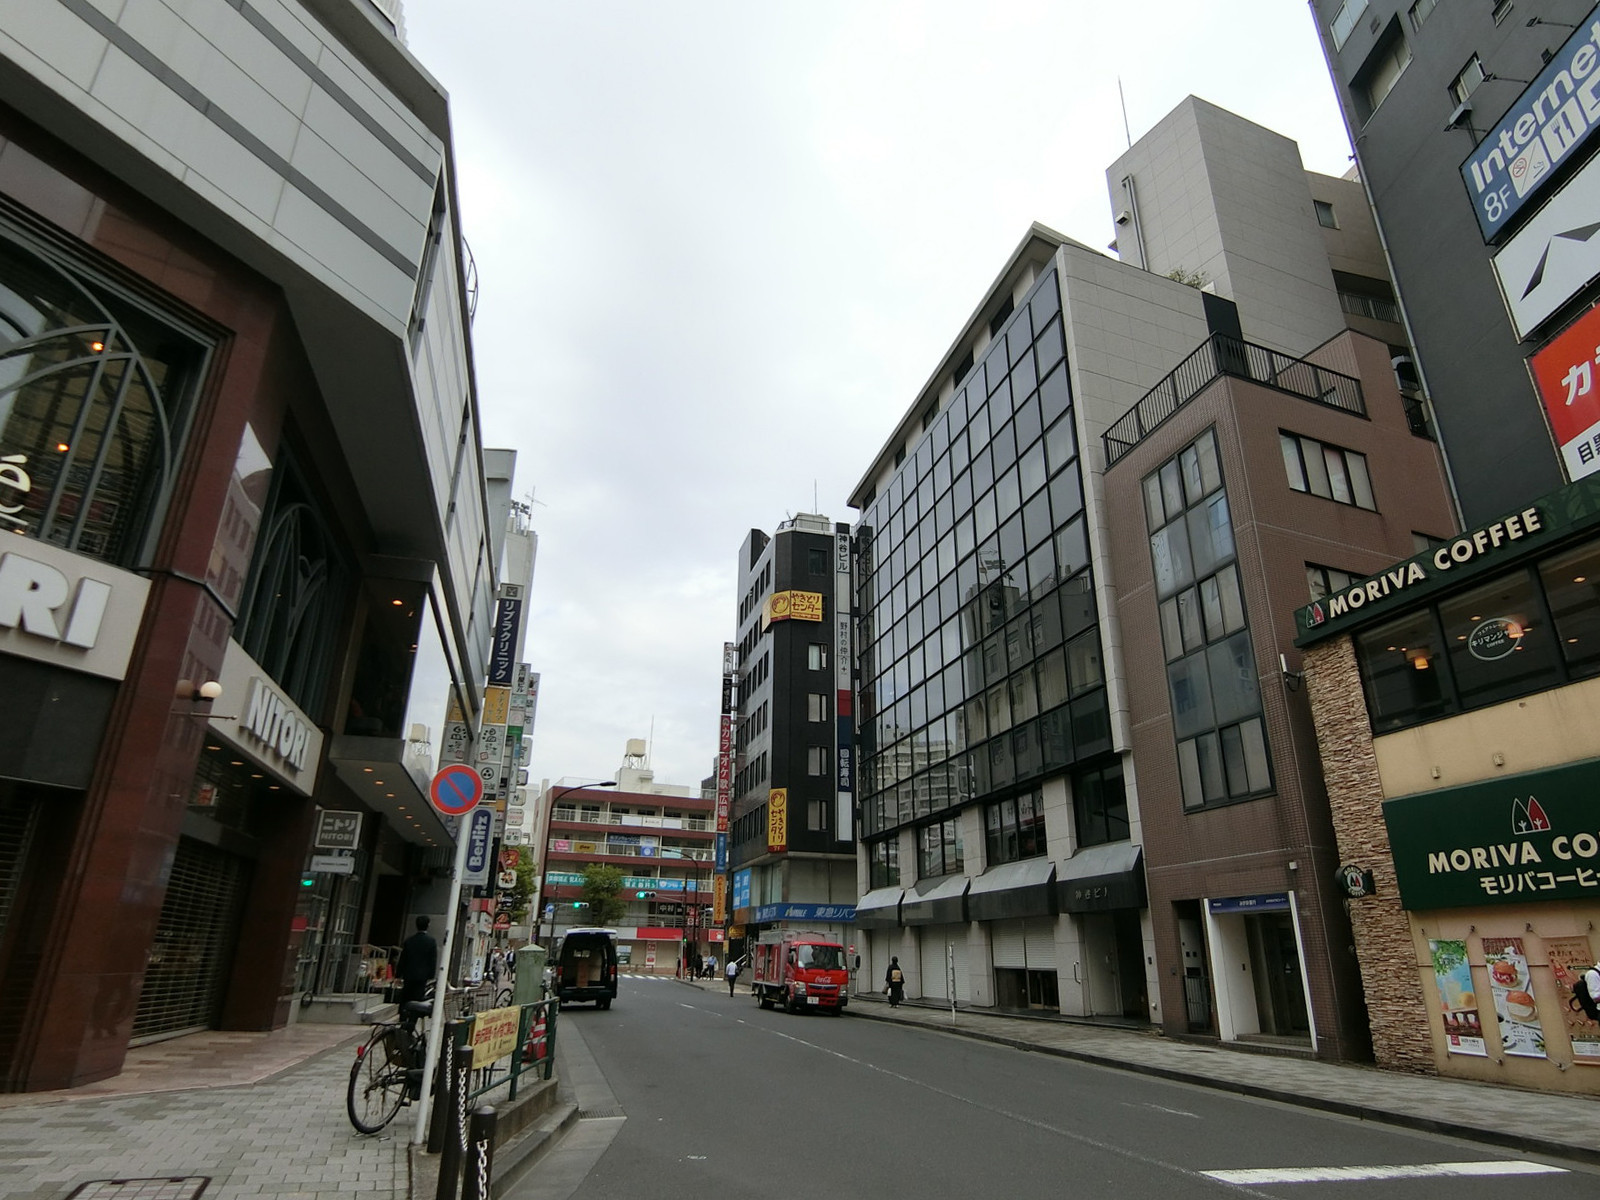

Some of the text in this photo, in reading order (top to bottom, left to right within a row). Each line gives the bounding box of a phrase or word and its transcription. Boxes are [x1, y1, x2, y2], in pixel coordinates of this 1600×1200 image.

[1470, 20, 1600, 193] Internet
[1484, 184, 1511, 223] 8F
[1329, 507, 1541, 618] MORIVA COFFEE
[791, 602, 821, 612] センター
[792, 592, 820, 604] やきとり
[496, 600, 515, 680] リブラクリニック
[1471, 627, 1517, 647] キリマンジャ
[240, 676, 312, 772] NITORI
[321, 832, 354, 841] NITORI
[322, 818, 356, 831] ニトリ
[468, 815, 488, 867] Berlitz
[770, 808, 778, 843] センター
[1428, 831, 1600, 874] MORIVA CO
[1480, 867, 1600, 896] モリバコーヒ
